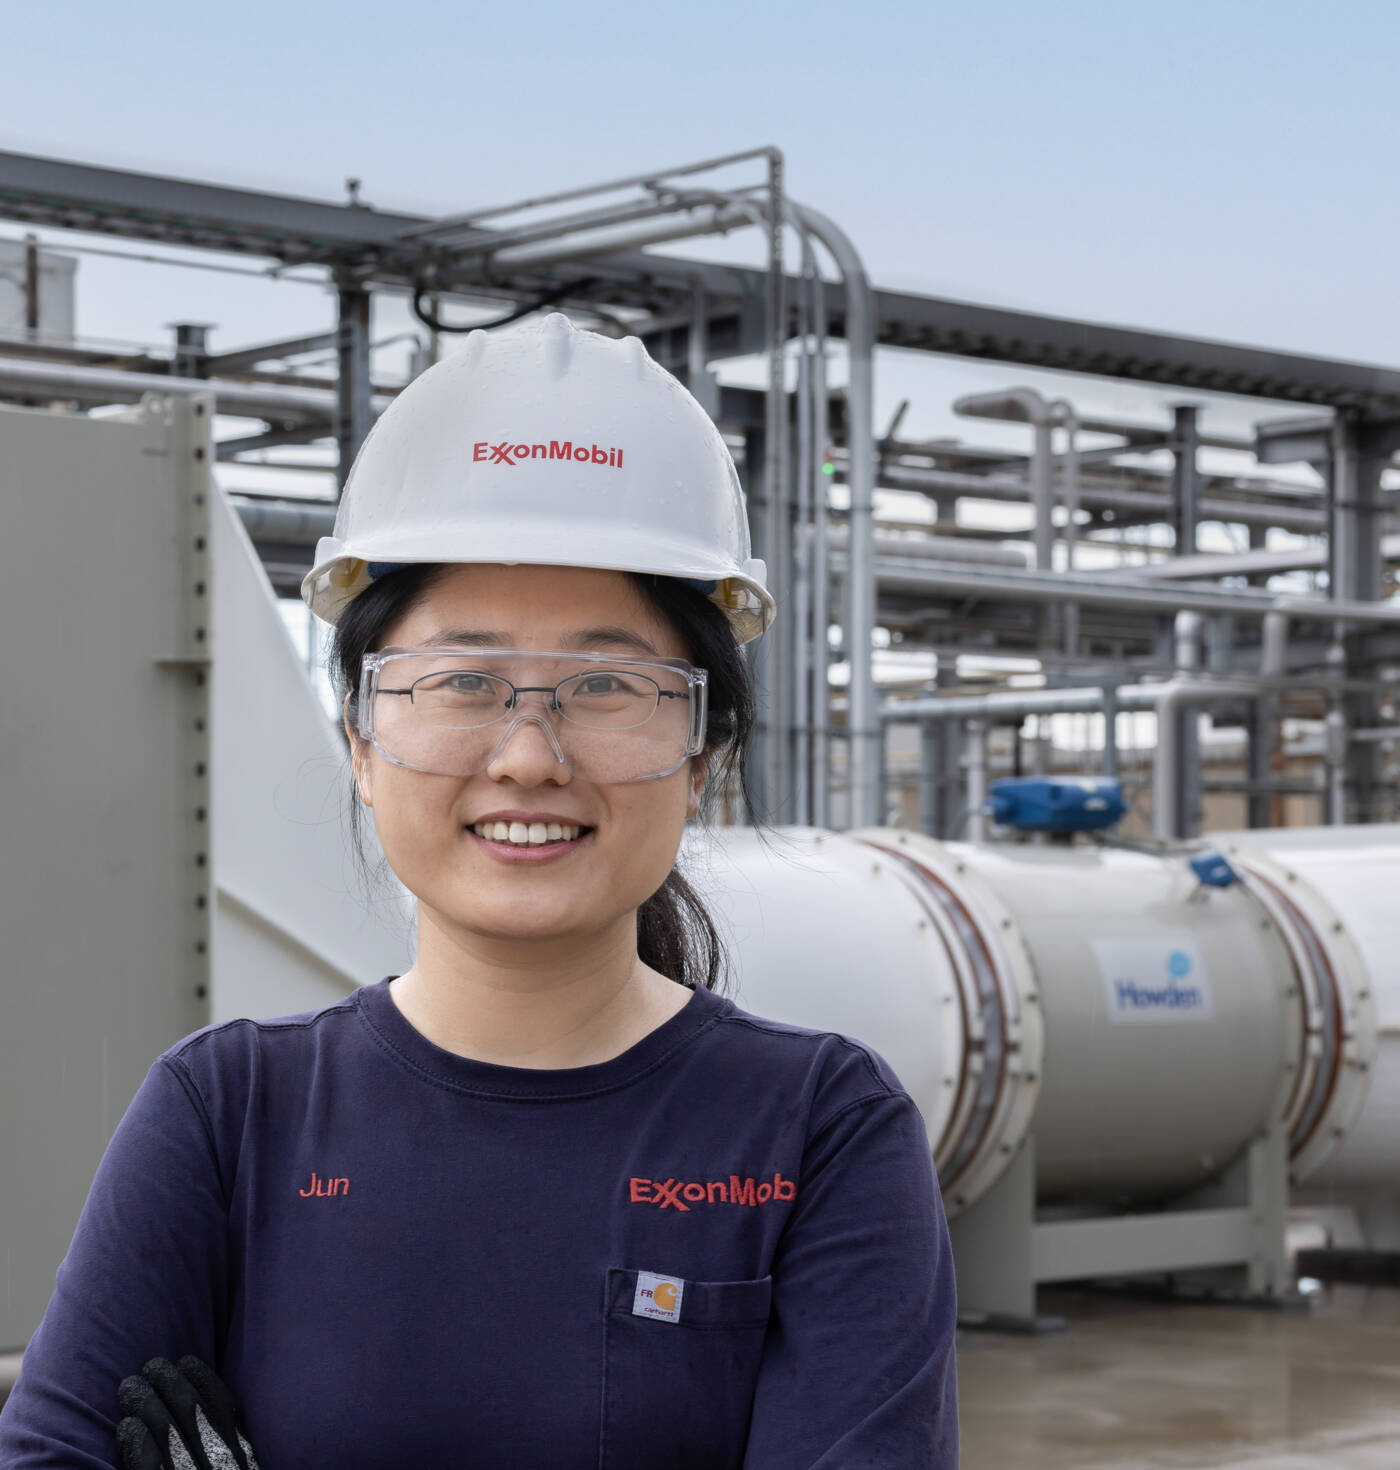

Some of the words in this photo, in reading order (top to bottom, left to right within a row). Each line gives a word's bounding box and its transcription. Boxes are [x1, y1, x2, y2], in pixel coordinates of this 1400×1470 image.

[473, 440, 623, 468] ExxonMobil
[299, 1172, 350, 1198] Jun
[640, 1288, 654, 1299] FR
